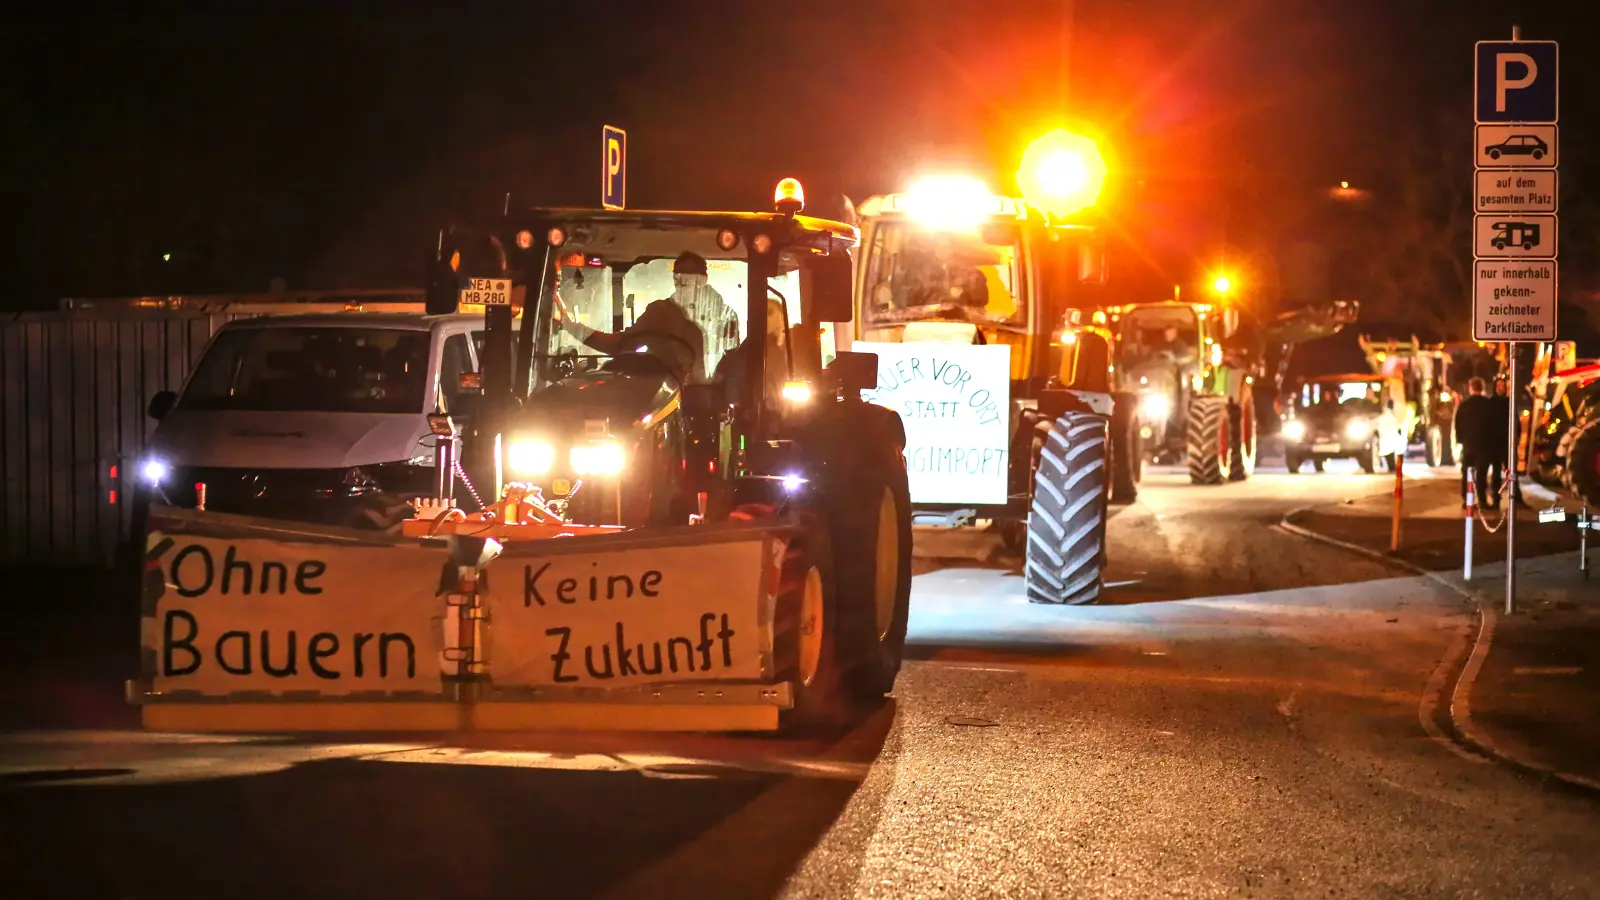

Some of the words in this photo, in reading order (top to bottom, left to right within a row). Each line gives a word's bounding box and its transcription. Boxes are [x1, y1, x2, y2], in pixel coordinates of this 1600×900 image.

[1495, 52, 1538, 113] P
[607, 138, 621, 197] P
[1496, 177, 1512, 188] auf
[1516, 177, 1536, 188] dem
[1480, 194, 1525, 207] gesamten
[1528, 192, 1552, 205] Platz
[1480, 269, 1498, 279] nur
[1502, 267, 1550, 279] innerhalb
[470, 279, 492, 291] NEA
[1493, 285, 1537, 300] gekenn-
[465, 291, 481, 303] MB
[1489, 304, 1541, 316] zeichneter
[1484, 321, 1545, 334] Parkflächen
[932, 357, 972, 395] VOR
[968, 389, 1002, 426] ORT
[904, 400, 961, 419] STATT
[907, 446, 1008, 477] IGIMPORT
[170, 544, 326, 598] Ohne
[523, 561, 663, 607] Keine
[163, 609, 416, 680] Bauern
[545, 612, 735, 683] Zukunft
